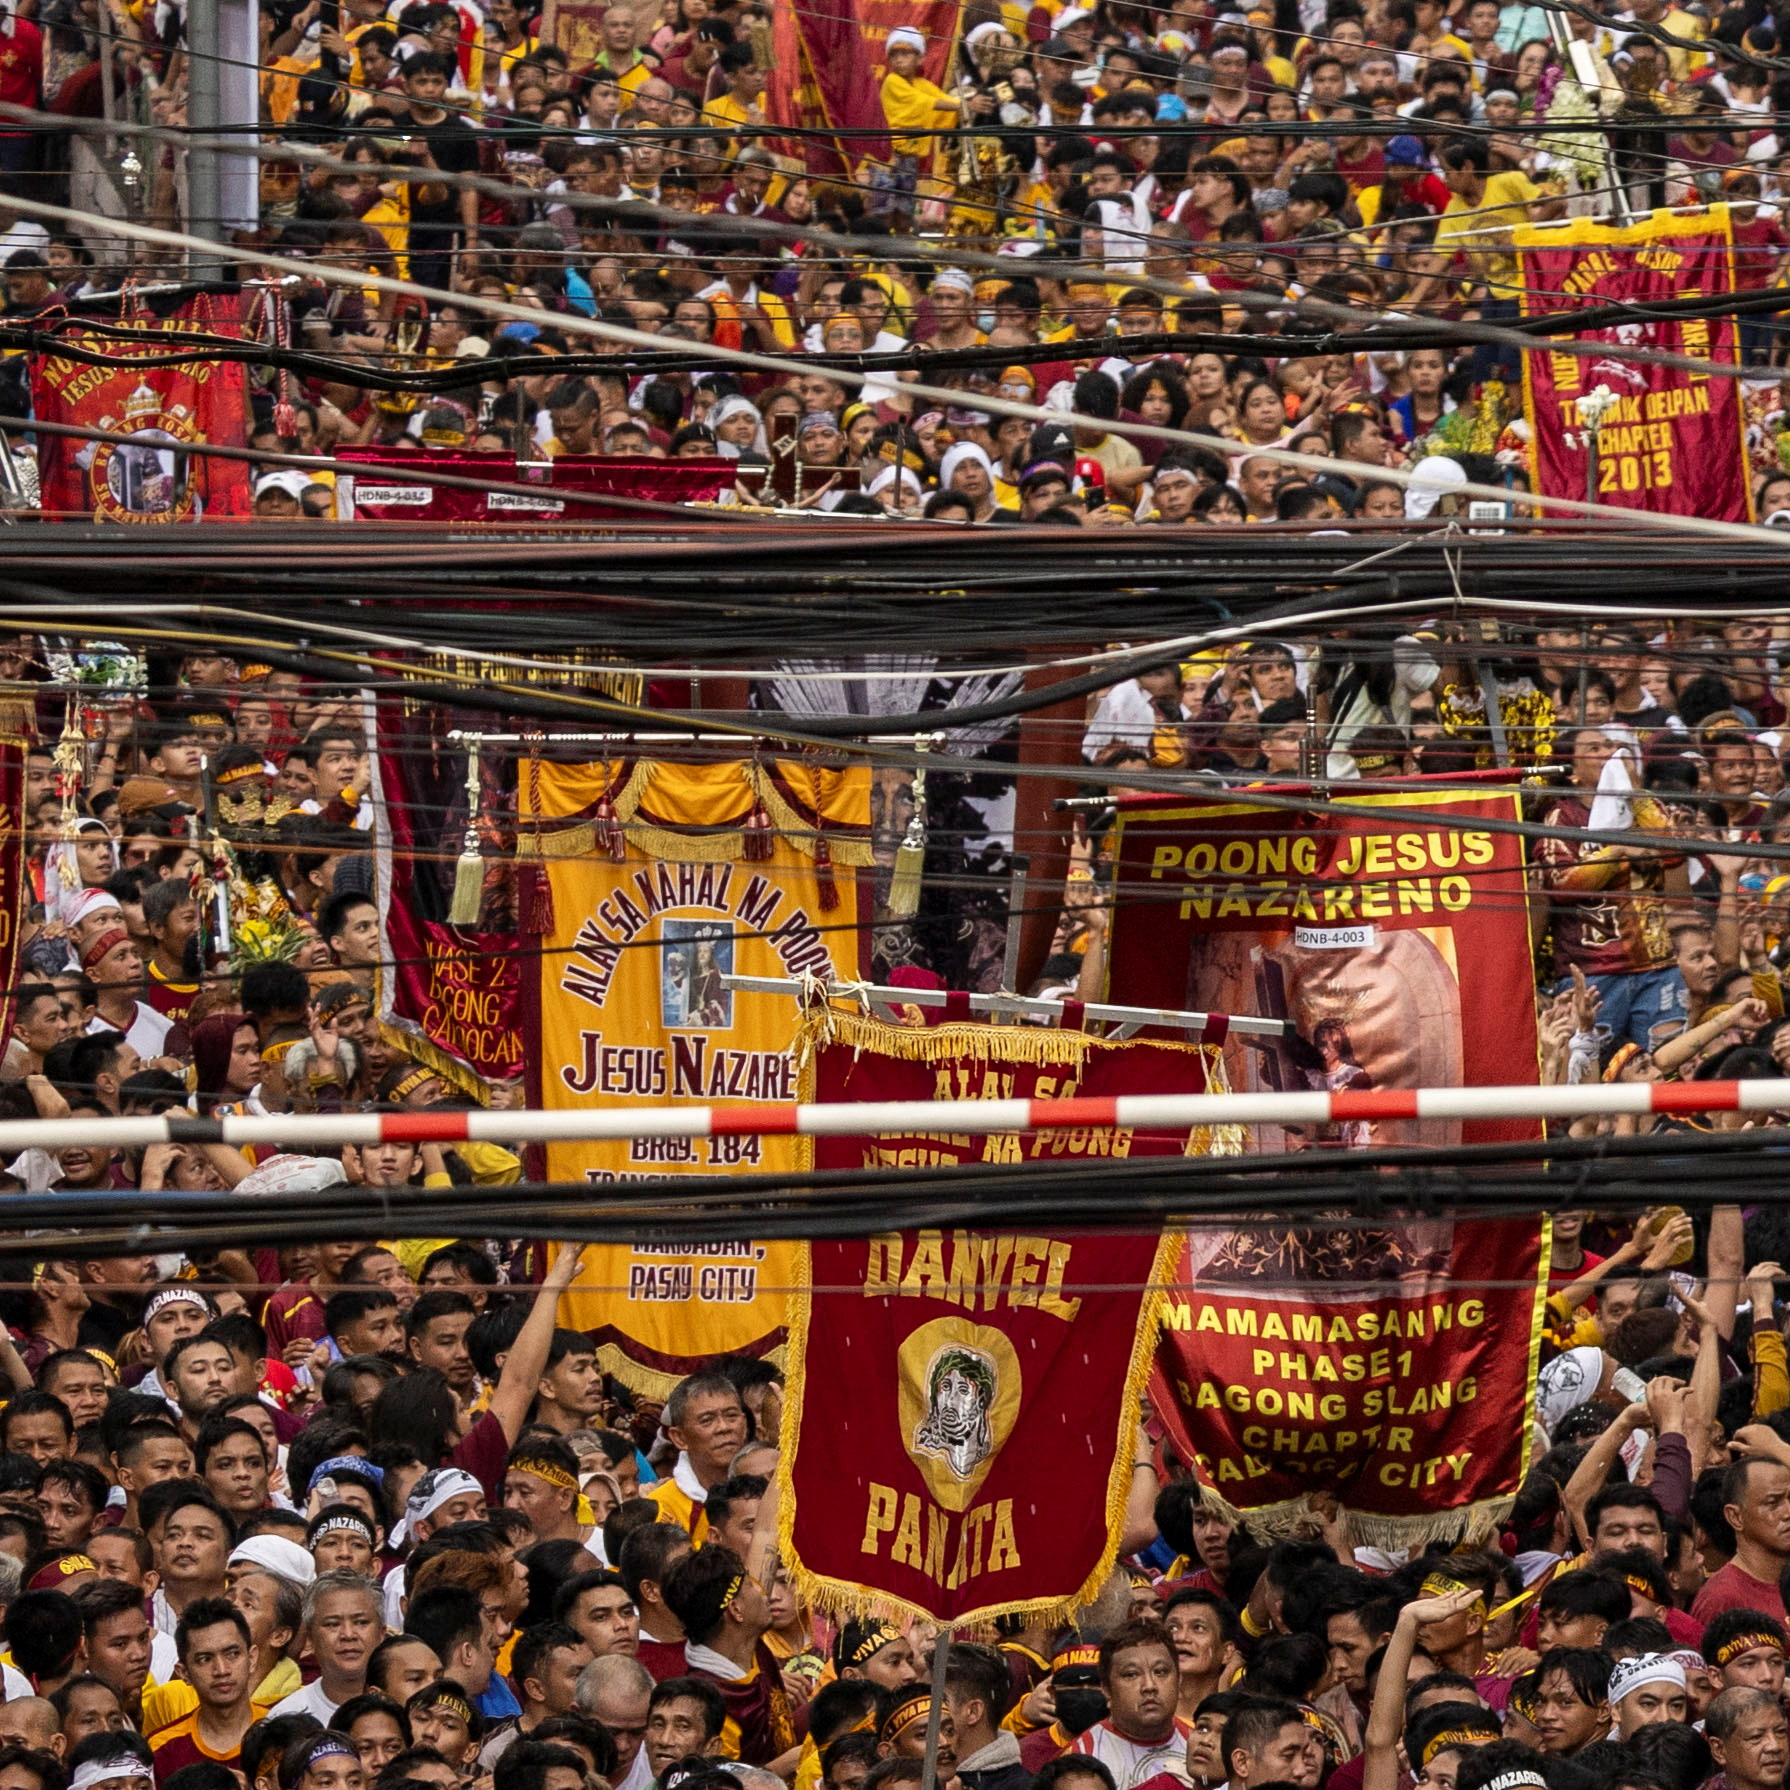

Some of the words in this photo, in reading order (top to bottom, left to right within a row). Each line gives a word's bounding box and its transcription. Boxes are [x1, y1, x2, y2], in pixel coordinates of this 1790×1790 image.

[1646, 387, 1714, 421] DELPAN
[1598, 457, 1674, 493] 2013
[1153, 836, 1330, 876] POONG
[1344, 829, 1500, 870] JESUS
[640, 860, 738, 914] MAHAL
[1180, 873, 1477, 918] NAZARENO
[559, 1028, 676, 1096] JESUS
[708, 1134, 765, 1165] 184
[627, 1262, 696, 1301] PASAY
[699, 1263, 762, 1303] CITY
[1243, 1425, 1413, 1454] CHAPTR
[1378, 1451, 1470, 1488] CITY
[853, 1633, 883, 1662] VIVA
